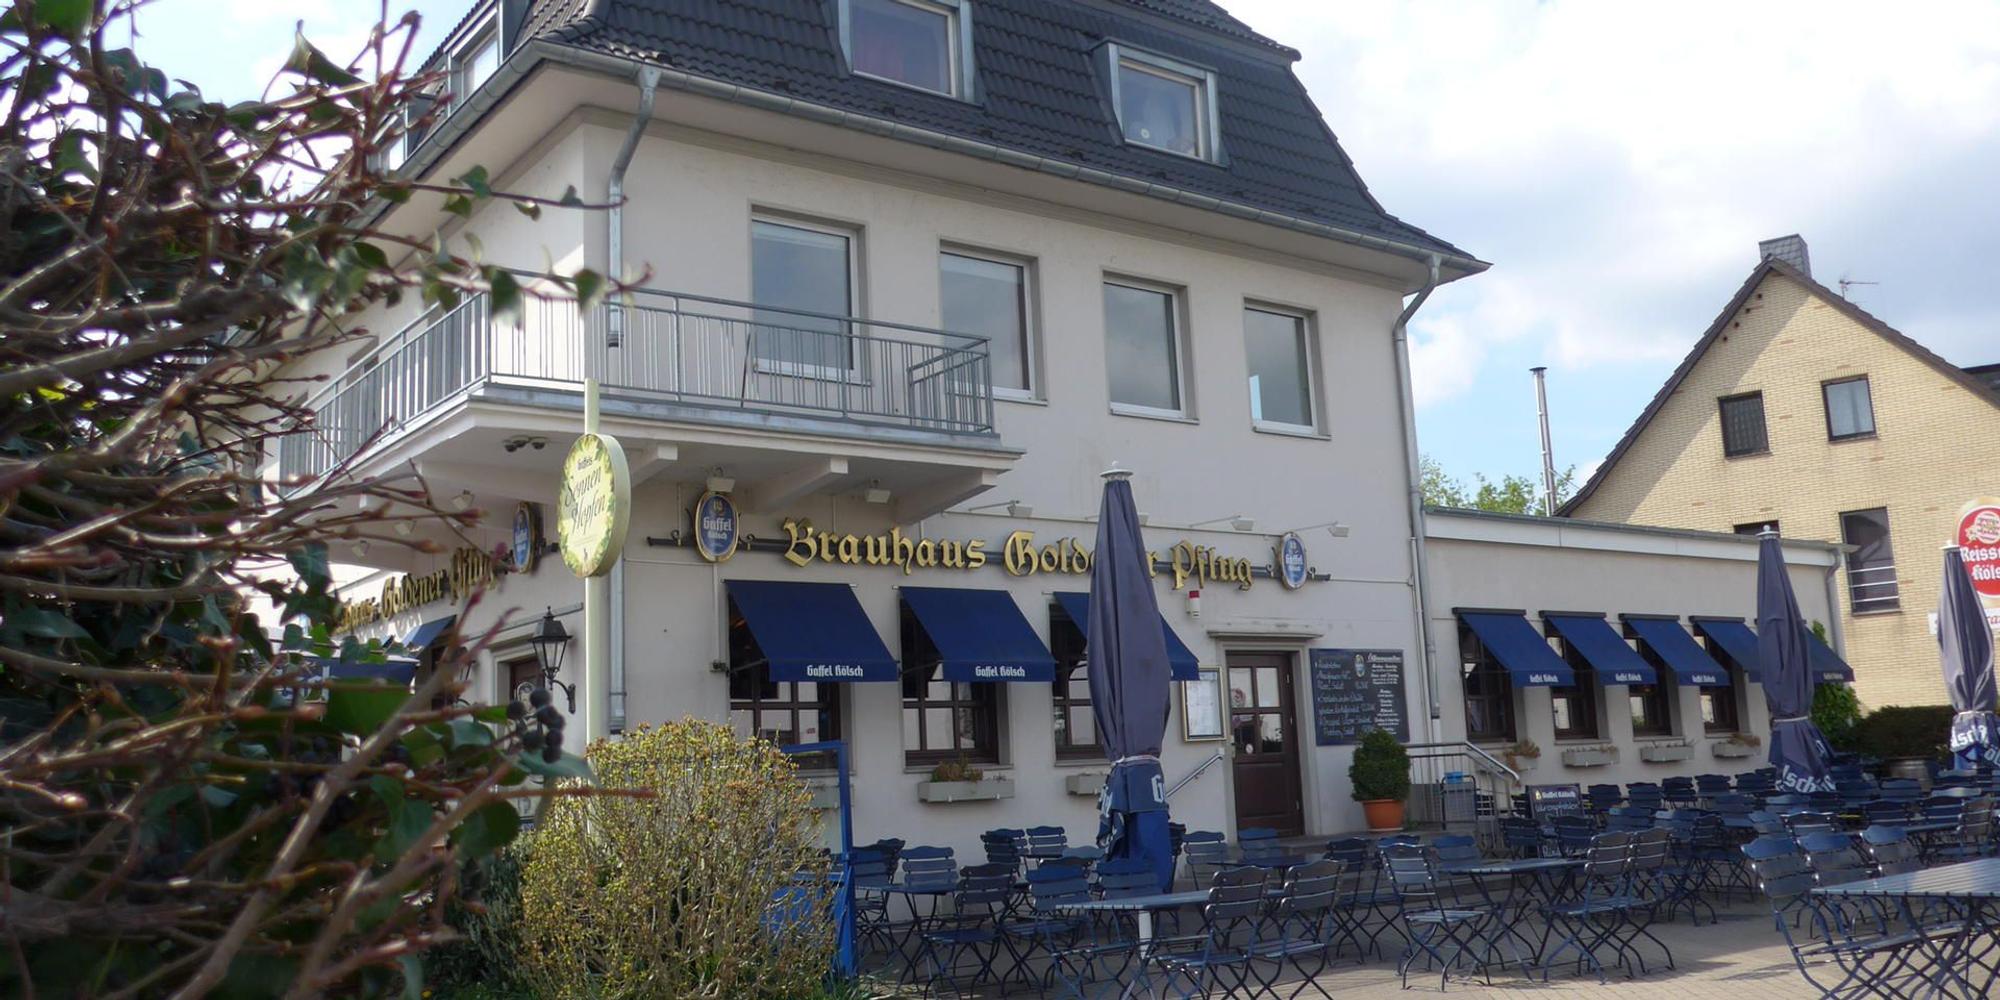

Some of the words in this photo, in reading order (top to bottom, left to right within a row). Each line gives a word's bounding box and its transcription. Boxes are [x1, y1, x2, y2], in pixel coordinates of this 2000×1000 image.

[703, 516, 732, 532] Gaffel
[783, 516, 986, 576] Brauhaus
[1003, 530, 1159, 579] Goldr
[1169, 539, 1252, 592] Pflug
[1960, 546, 2000, 562] Reiss
[1972, 564, 2000, 581] Köls
[381, 572, 449, 622] Goldener
[806, 664, 834, 678] Gaffel
[834, 664, 864, 678] Kölsch
[975, 665, 1001, 678] Gaffel
[1000, 665, 1026, 678] Kölsch
